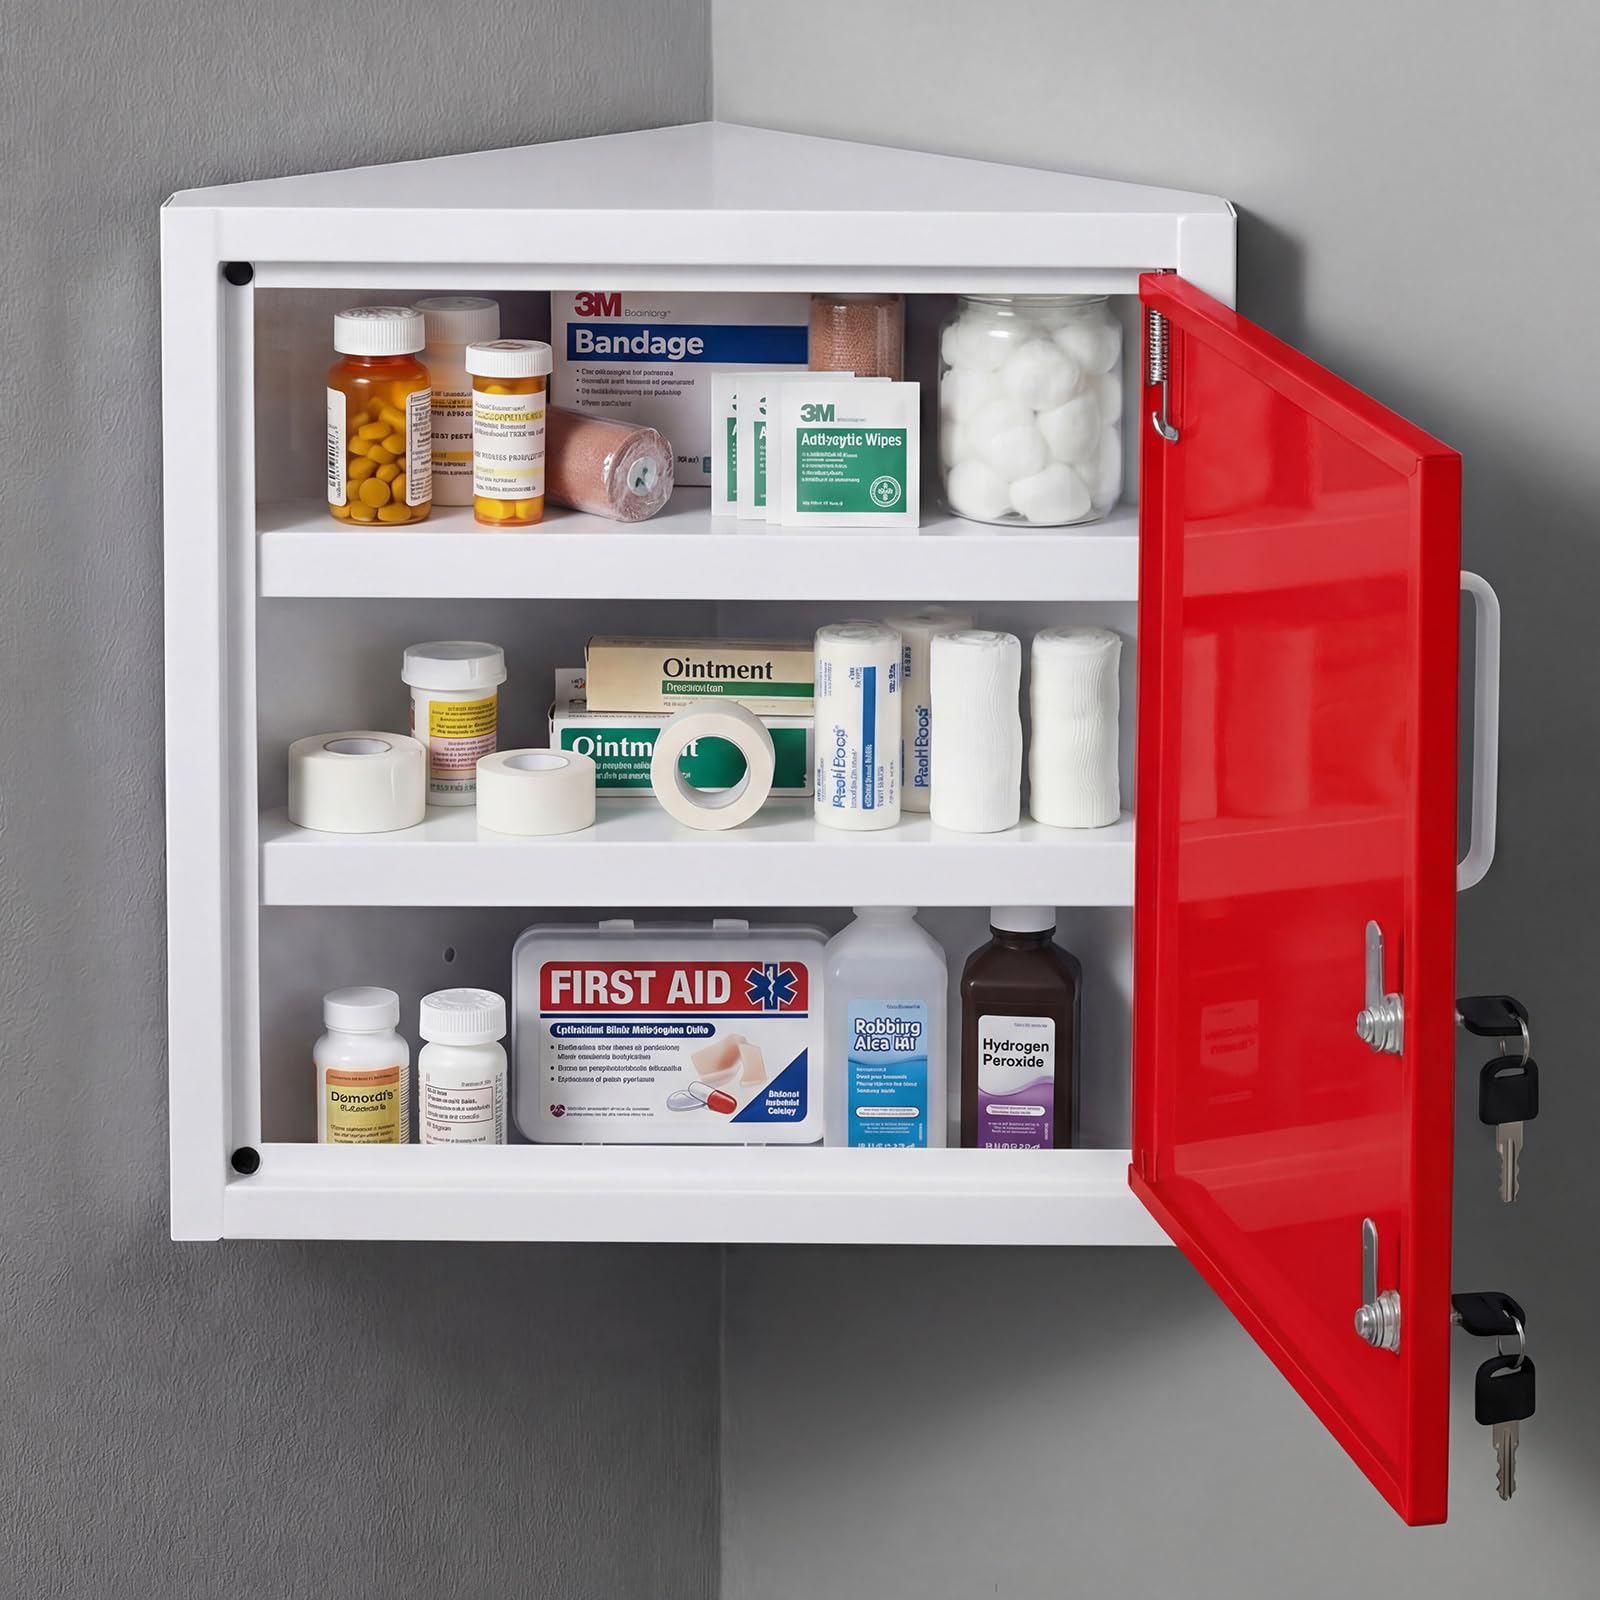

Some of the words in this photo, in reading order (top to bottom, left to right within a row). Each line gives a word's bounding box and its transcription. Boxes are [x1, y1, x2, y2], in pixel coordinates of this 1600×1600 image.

[575, 292, 622, 317] 3M
[575, 329, 705, 361] Bandage
[800, 404, 835, 422] 3M
[865, 433, 902, 448] Wipes
[663, 657, 773, 680] Ointment
[551, 970, 656, 1005] FIRST
[666, 970, 731, 1005] AID
[983, 1038, 1049, 1054] Hydrogen
[983, 1054, 1044, 1067] Peroxide
